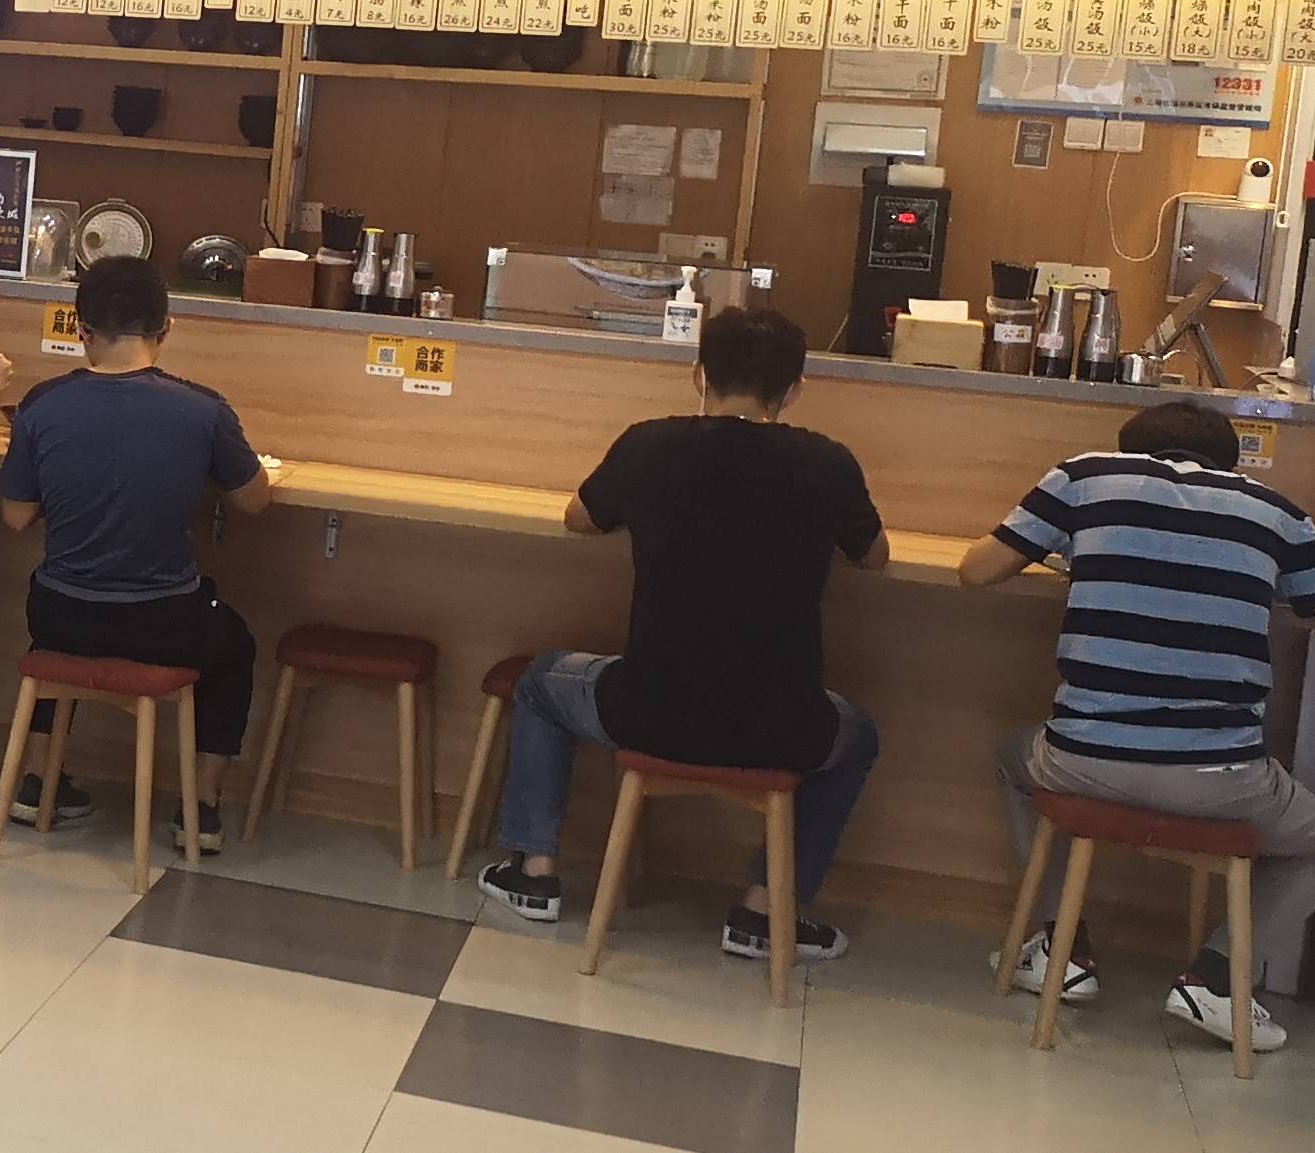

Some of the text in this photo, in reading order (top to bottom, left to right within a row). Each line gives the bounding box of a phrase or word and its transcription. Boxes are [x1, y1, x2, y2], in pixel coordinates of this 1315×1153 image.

[132, 1, 154, 13] 16元
[171, 3, 193, 15] 16元
[243, 4, 267, 16] 12元
[285, 8, 305, 19] 4元
[326, 8, 345, 20] 7元
[366, 10, 385, 22] 8元
[402, 12, 428, 25] 16元
[444, 14, 471, 27] 26元
[485, 15, 513, 28] 24元
[526, 17, 555, 30] 22元
[609, 21, 637, 34] 30元
[653, 24, 681, 37] 25元
[697, 28, 726, 41] 25元
[743, 29, 772, 42] 25元
[787, 31, 816, 44] 25元
[837, 32, 863, 45] 16元
[886, 33, 914, 46] 16元
[932, 37, 959, 49] 16元
[1025, 37, 1056, 50] 25元
[1076, 40, 1108, 54] 25元
[1128, 41, 1156, 54] 15元
[1180, 43, 1210, 56] 18元
[1234, 45, 1264, 58] 15元
[416, 346, 446, 360] 合作
[415, 359, 444, 374] 商家
